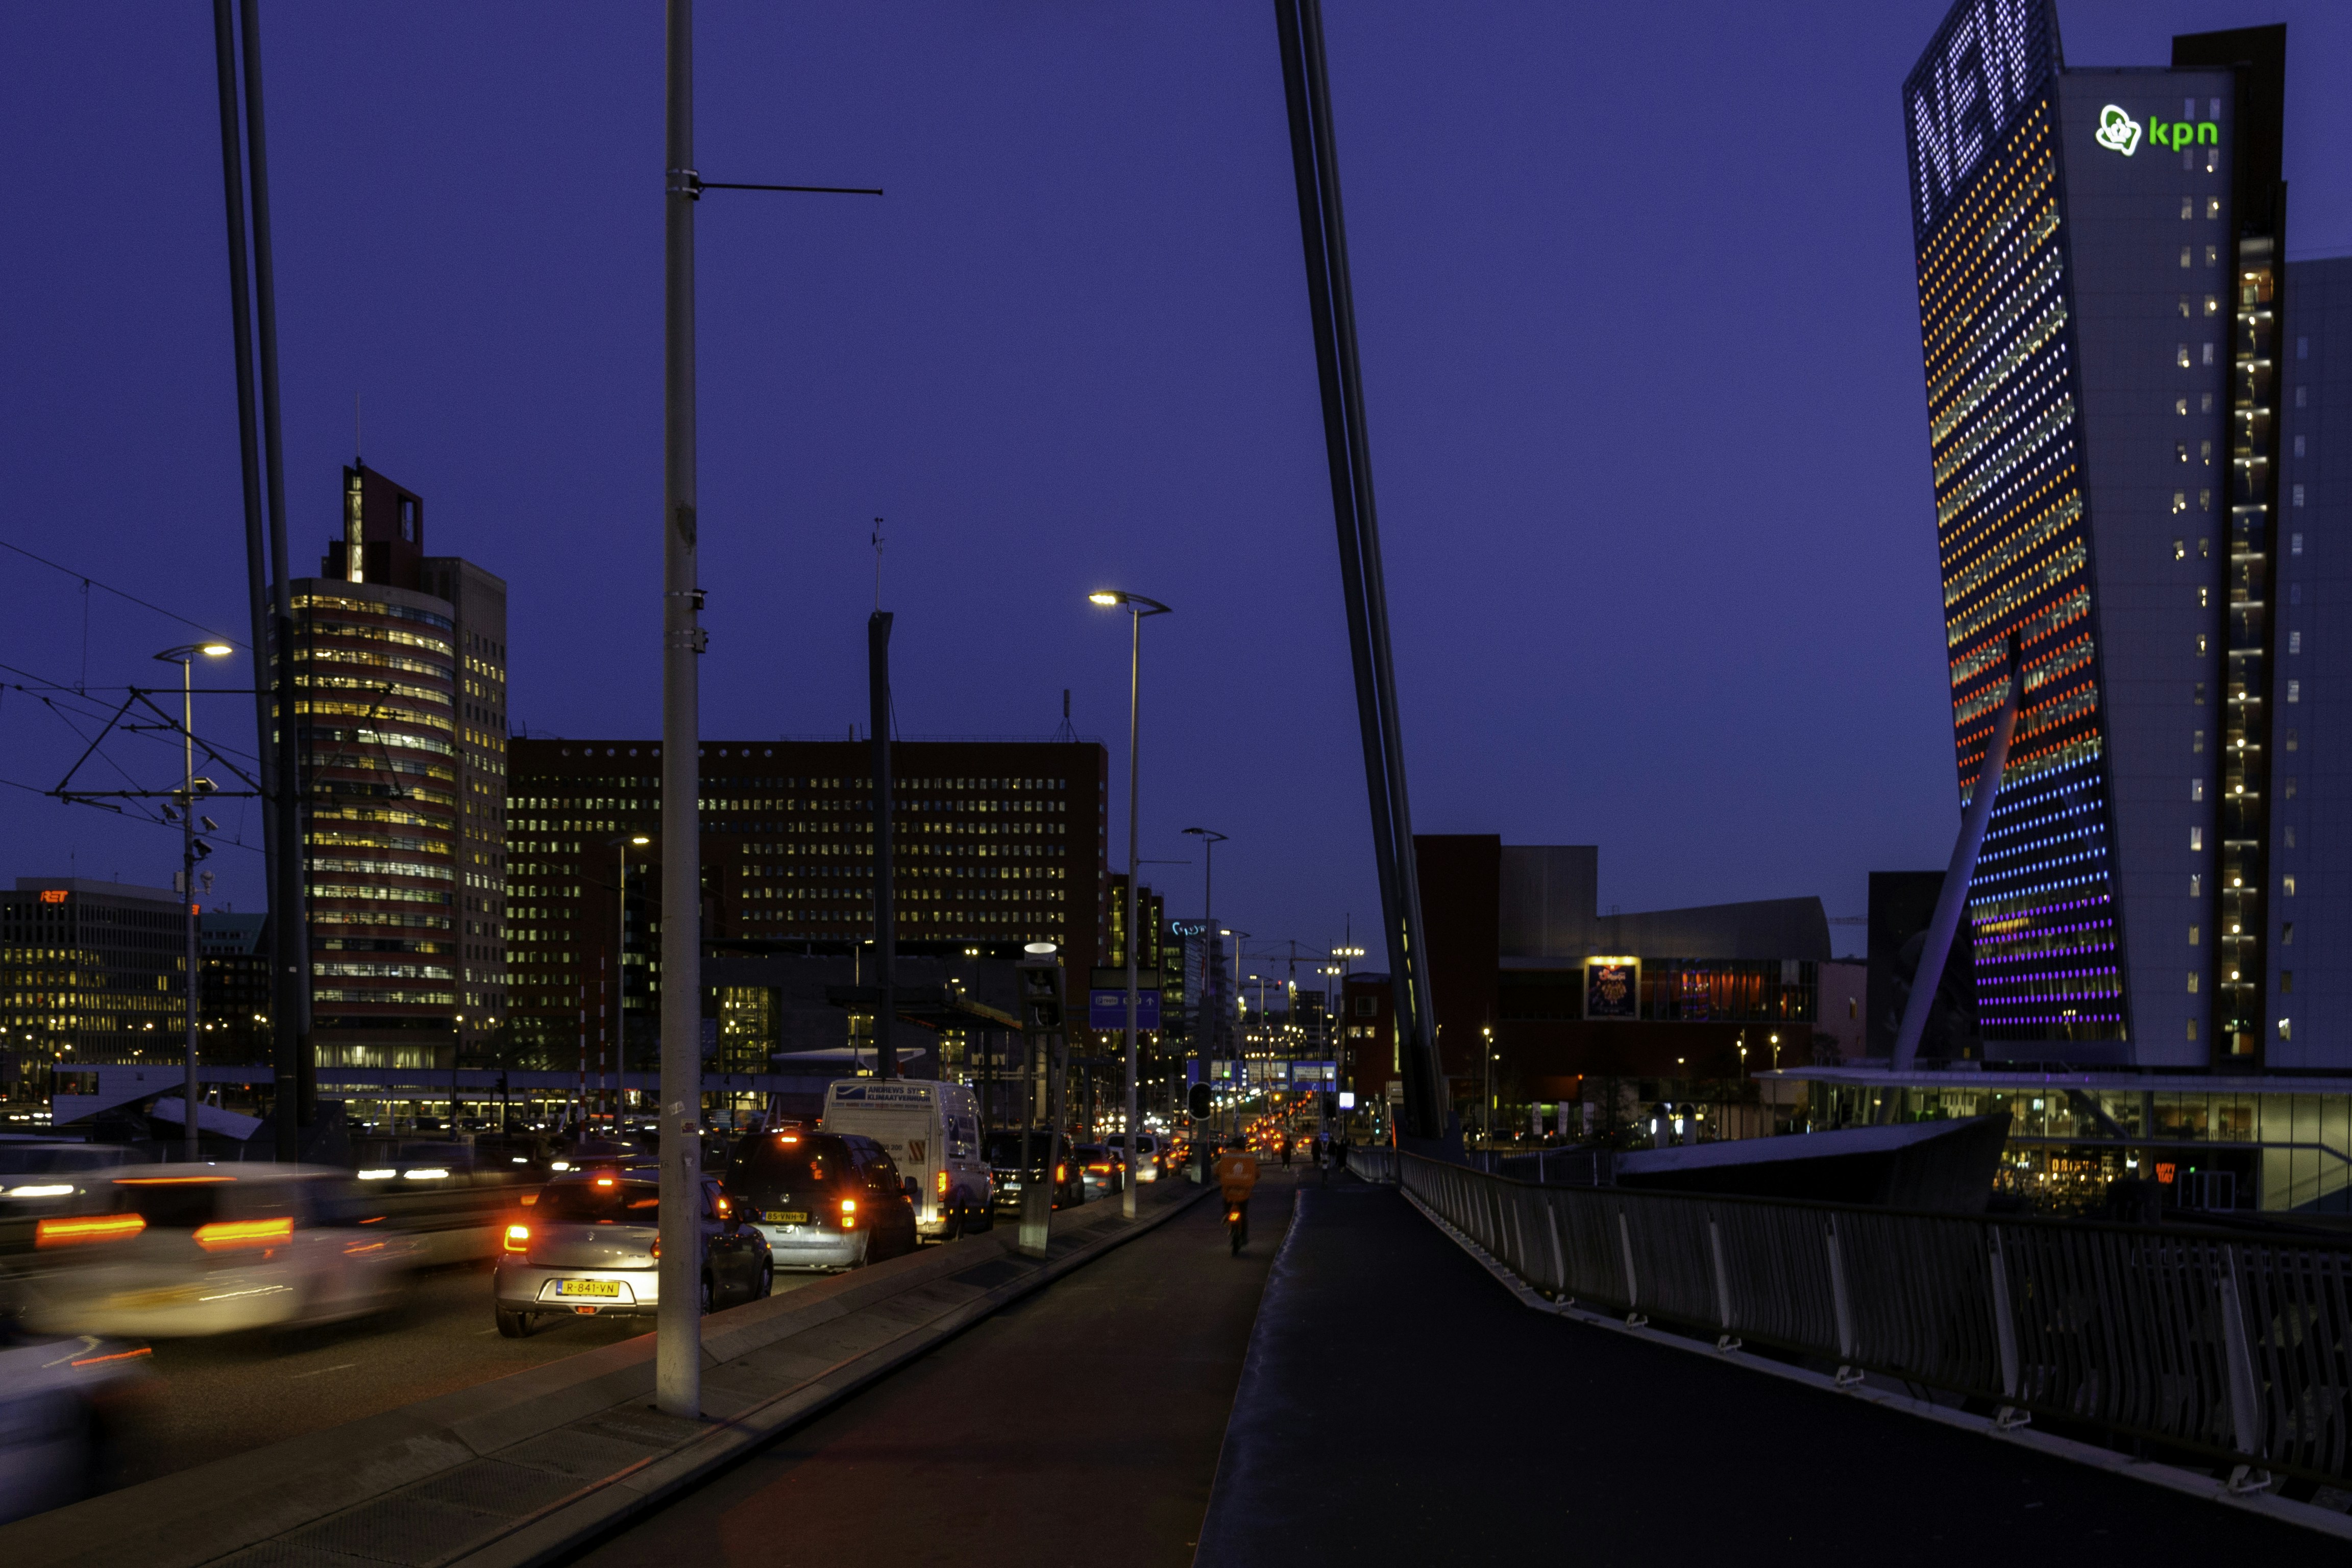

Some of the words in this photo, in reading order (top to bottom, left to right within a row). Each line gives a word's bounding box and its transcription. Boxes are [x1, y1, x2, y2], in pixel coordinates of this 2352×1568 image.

[2149, 116, 2218, 152] kpn
[41, 890, 68, 903] RET
[724, 1074, 730, 1085] 4
[749, 1075, 754, 1086] 1
[868, 1086, 904, 1094] ANDREWS
[868, 1094, 930, 1102] KLIMAATVERHUUR
[567, 1283, 614, 1293] R-841-VN
